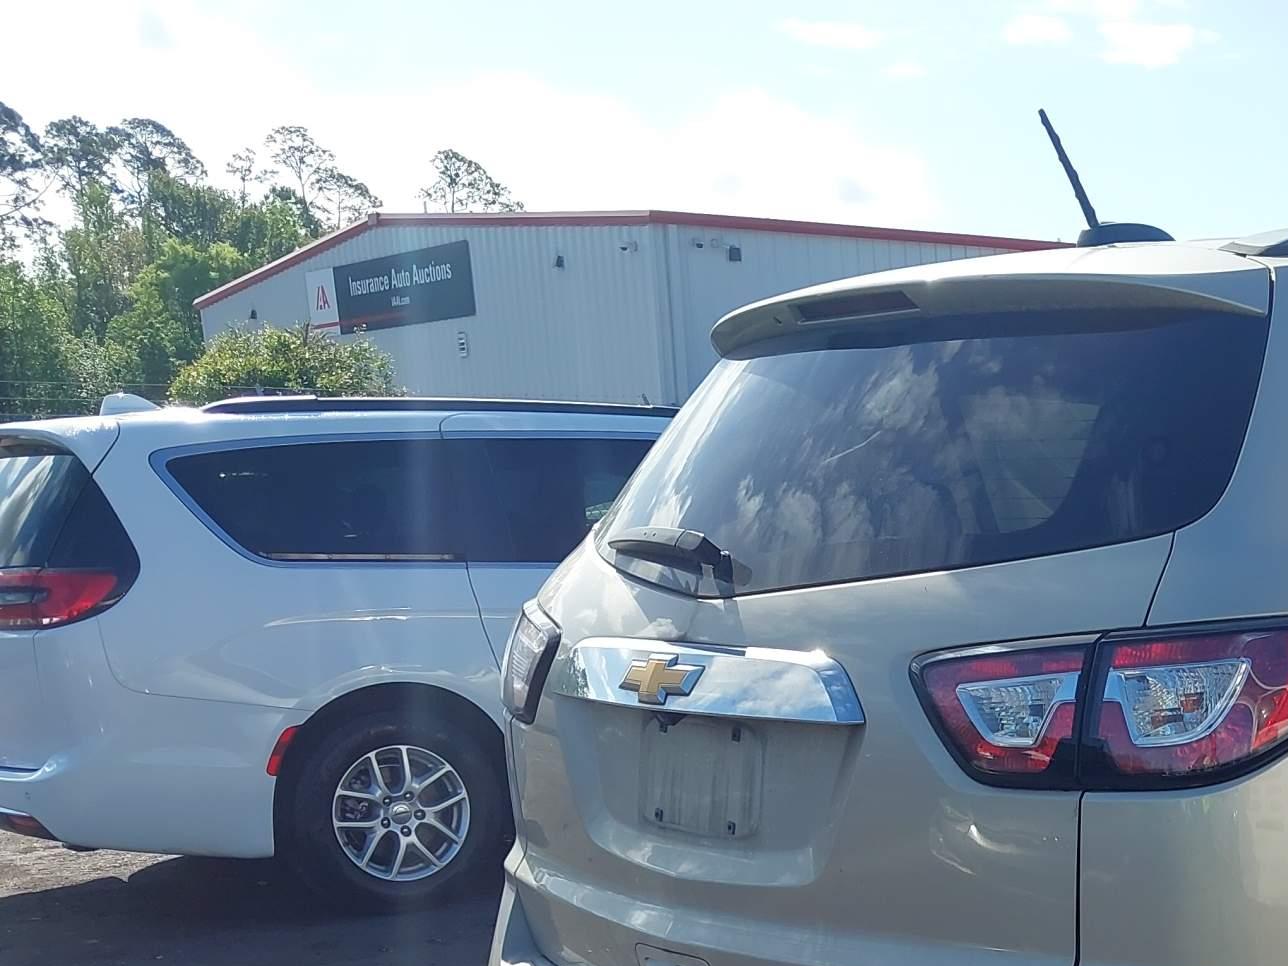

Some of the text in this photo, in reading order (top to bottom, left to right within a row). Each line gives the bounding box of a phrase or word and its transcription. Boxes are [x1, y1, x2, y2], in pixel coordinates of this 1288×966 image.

[348, 260, 452, 297] Insurance Auto Auctions
